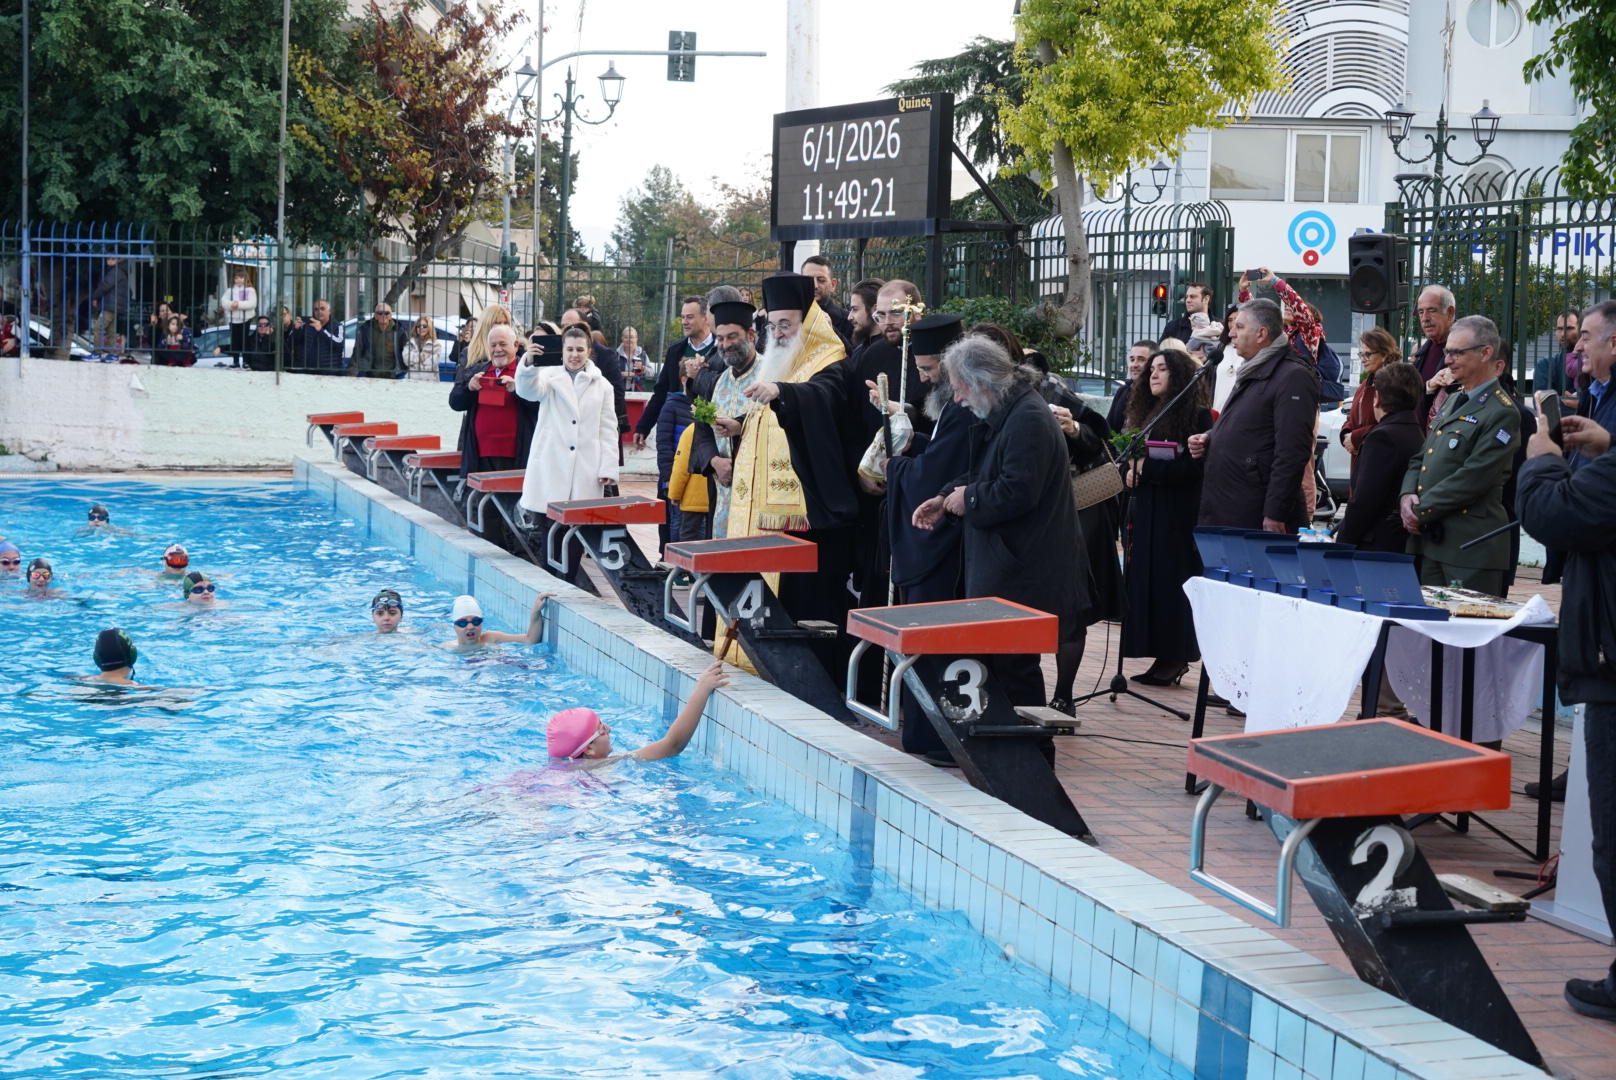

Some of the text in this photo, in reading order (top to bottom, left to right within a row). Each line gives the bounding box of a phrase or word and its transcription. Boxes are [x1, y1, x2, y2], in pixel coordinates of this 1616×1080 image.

[898, 96, 931, 113] Quince
[802, 118, 901, 172] 6/1/2026
[802, 177, 896, 221] 11:49:21
[600, 528, 629, 571] 5
[730, 579, 770, 627] 4
[940, 658, 988, 723] 3
[1350, 824, 1418, 920] 2
